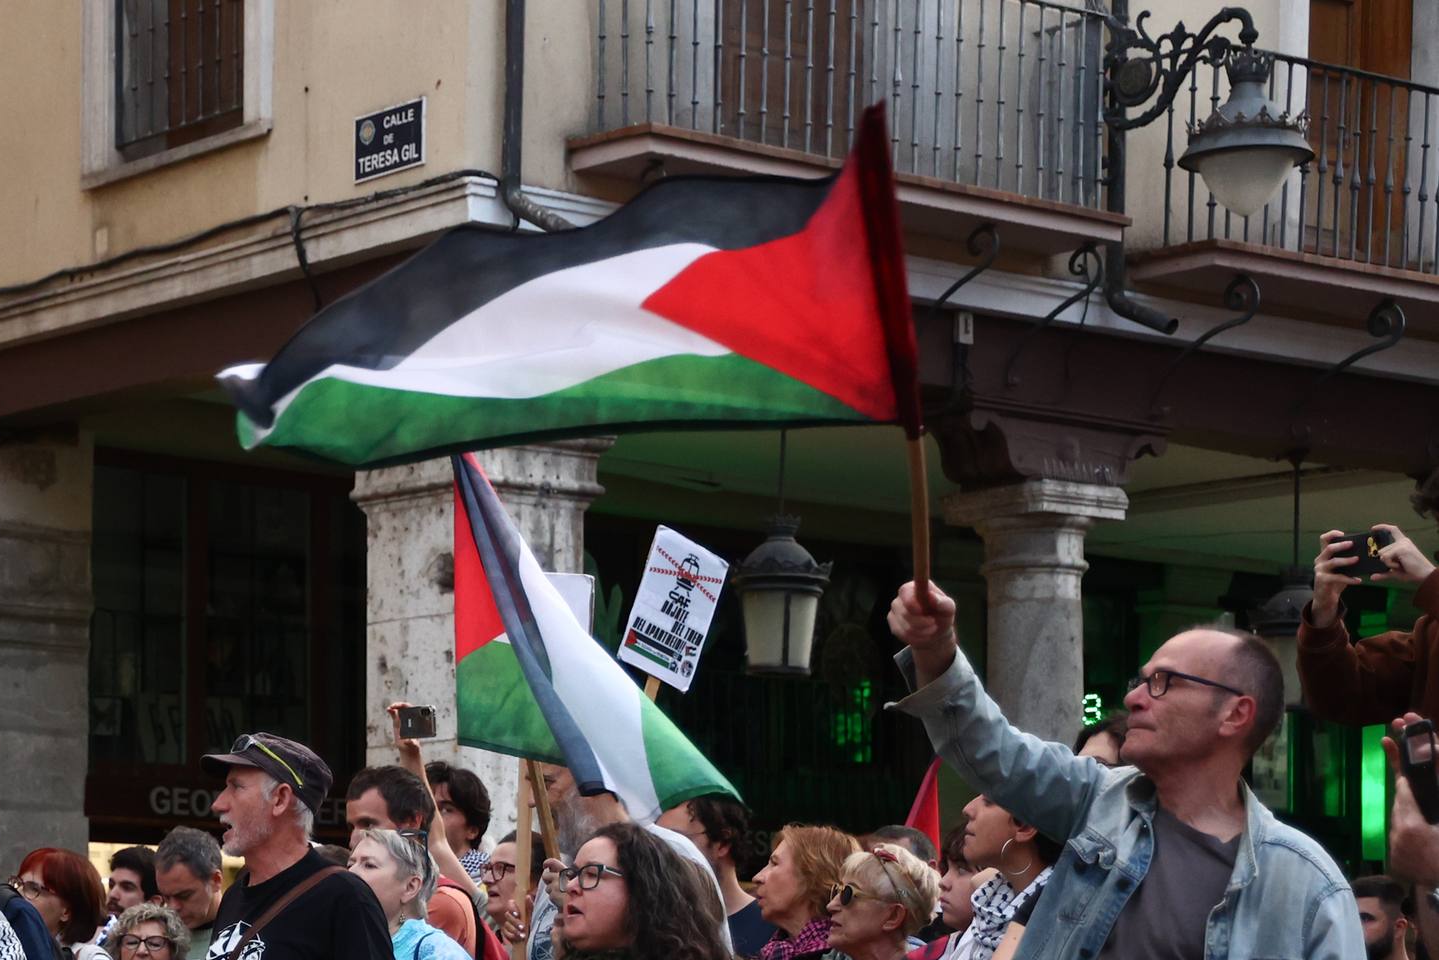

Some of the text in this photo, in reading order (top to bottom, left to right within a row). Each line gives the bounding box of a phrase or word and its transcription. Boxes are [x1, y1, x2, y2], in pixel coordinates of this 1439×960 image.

[383, 108, 414, 129] CALLE
[383, 133, 394, 145] DE
[358, 143, 419, 174] TERESA GIL
[149, 785, 221, 817] GEO
